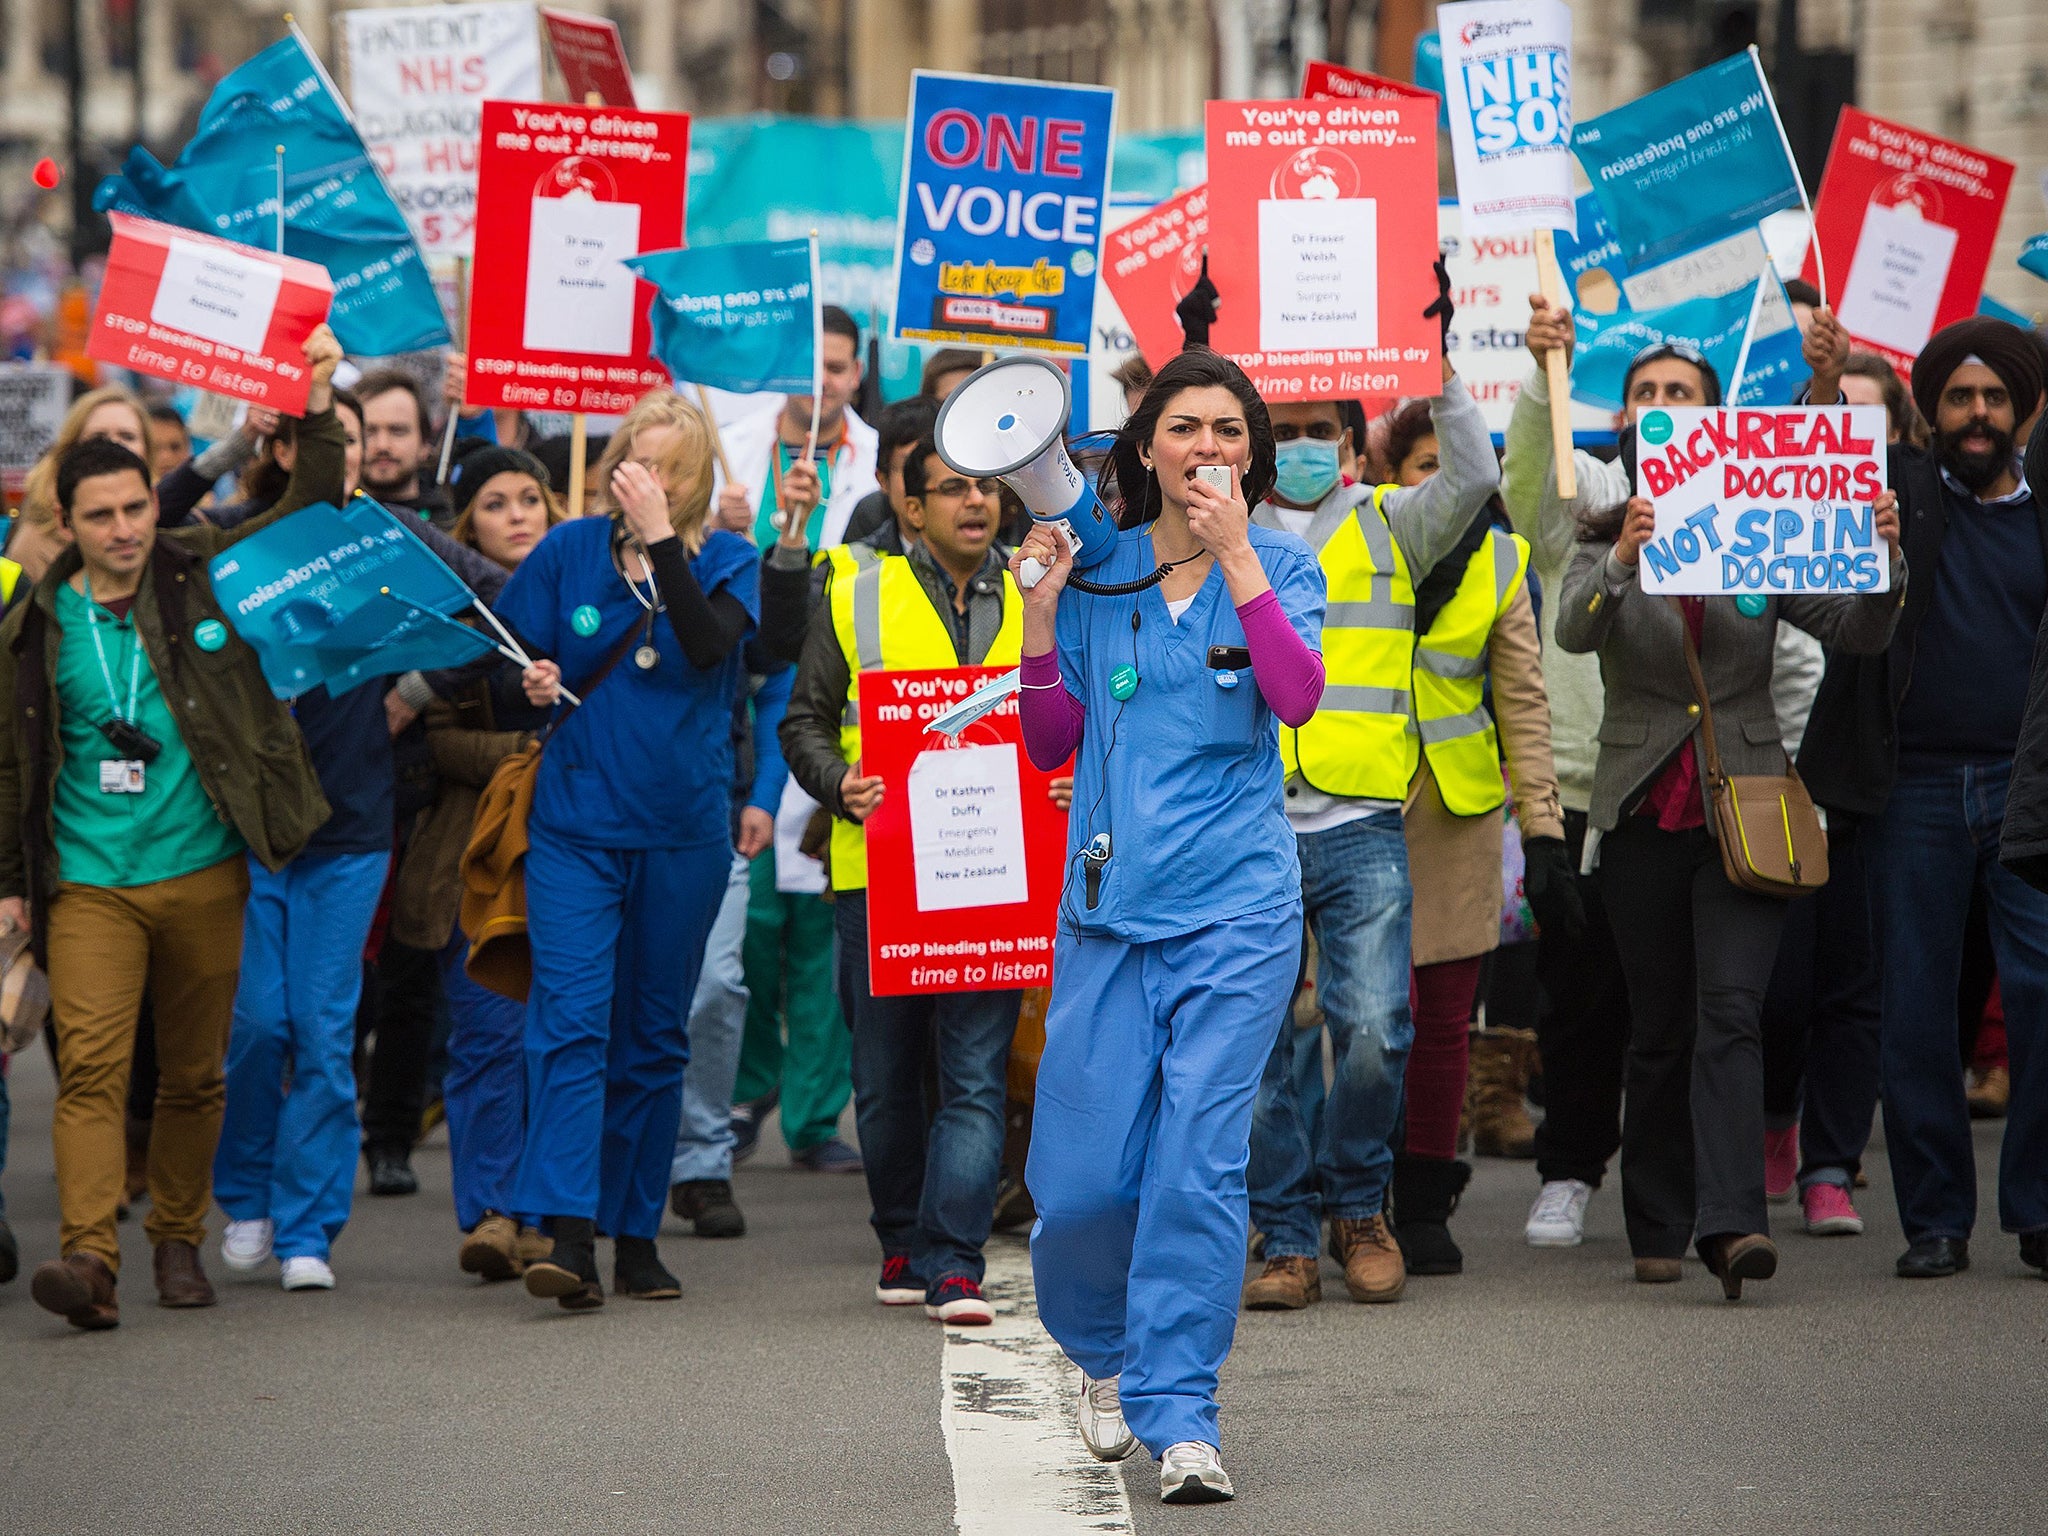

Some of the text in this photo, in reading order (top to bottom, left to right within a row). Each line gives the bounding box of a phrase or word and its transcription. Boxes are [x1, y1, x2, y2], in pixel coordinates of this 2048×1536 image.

[398, 56, 488, 94] NHS
[1466, 51, 1570, 111] NHS
[512, 108, 659, 140] You've driven
[1241, 105, 1400, 127] You've driven
[1475, 98, 1570, 151] SOS
[496, 131, 672, 163] me out Jeremy...
[924, 107, 1086, 180] ONE
[1226, 126, 1416, 149] me out Jeremy...
[1848, 136, 1880, 162] me
[1880, 147, 1915, 171] out
[1867, 121, 1989, 178] You've driven
[915, 181, 1099, 246] VOICE
[1114, 188, 1208, 252] You've dr
[1113, 250, 1148, 279] me
[1148, 230, 1185, 260] out
[1185, 214, 1208, 241] Je
[1471, 236, 1536, 264] you
[1569, 240, 1622, 272] work
[104, 312, 304, 381] STOP bleeding the NHS dry
[1266, 351, 1335, 368] bleeding
[1337, 348, 1363, 364] the
[1366, 347, 1401, 363] NHS
[1402, 346, 1430, 365] dry
[127, 343, 269, 398] time to listen
[475, 357, 665, 387] STOP bleeding the NHS dry
[1253, 370, 1400, 396] time to listen
[502, 381, 637, 410] time to listen
[1640, 407, 1876, 498] BACK REAL
[1723, 461, 1883, 502] DOCTORS
[1643, 503, 1724, 584] NOT
[1721, 551, 1881, 593] DOCTORS
[892, 675, 969, 700] You've
[878, 699, 955, 722] me out
[935, 784, 996, 800] Dr Kathryn
[951, 804, 982, 819] Duffy
[938, 825, 999, 842] Emergency
[944, 844, 995, 858] Medicine
[935, 864, 1008, 880] New Zealand
[879, 936, 1049, 960] STOP bleeding the NHS
[910, 960, 1049, 987] time to listen
